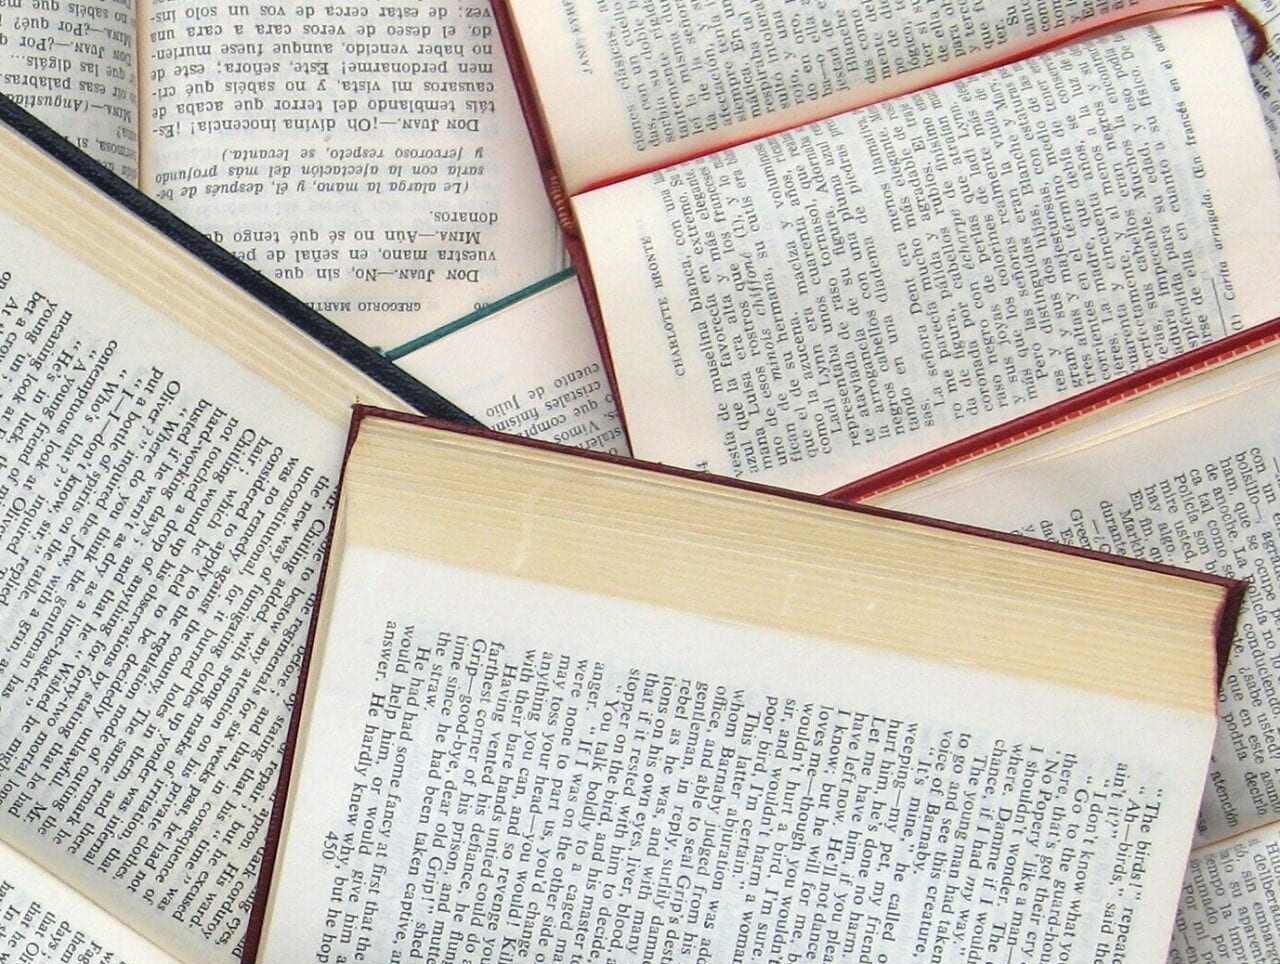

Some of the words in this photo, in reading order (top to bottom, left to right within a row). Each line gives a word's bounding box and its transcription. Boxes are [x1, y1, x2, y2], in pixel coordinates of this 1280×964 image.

[1159, 58, 1173, 70] el
[1168, 77, 1181, 93] en
[1175, 100, 1198, 147] francés
[660, 188, 676, 213] una
[429, 210, 498, 226] donaros.
[670, 218, 686, 247] con
[1200, 188, 1224, 251] arrugada.
[274, 265, 304, 280] que
[315, 267, 341, 282] sin
[681, 254, 703, 313] blanca,
[1218, 260, 1236, 301] Carita
[357, 301, 421, 312] GREGORIO
[656, 296, 686, 377] CHARLOTTE
[1230, 313, 1245, 332] (1)
[697, 320, 724, 394] muselina
[716, 402, 731, 422] de
[723, 430, 744, 478] vestía
[1158, 478, 1179, 514] mire
[1173, 519, 1198, 564] usted,
[434, 631, 452, 657] the
[422, 663, 443, 711] straw.
[934, 729, 953, 772] voice
[981, 738, 1008, 799] chance,
[929, 776, 945, 797] of
[978, 806, 996, 821] if
[911, 801, 942, 875] Barnaby.
[975, 824, 991, 834] I
[321, 830, 339, 860] 450
[968, 838, 989, 870] had
[959, 875, 976, 902] my
